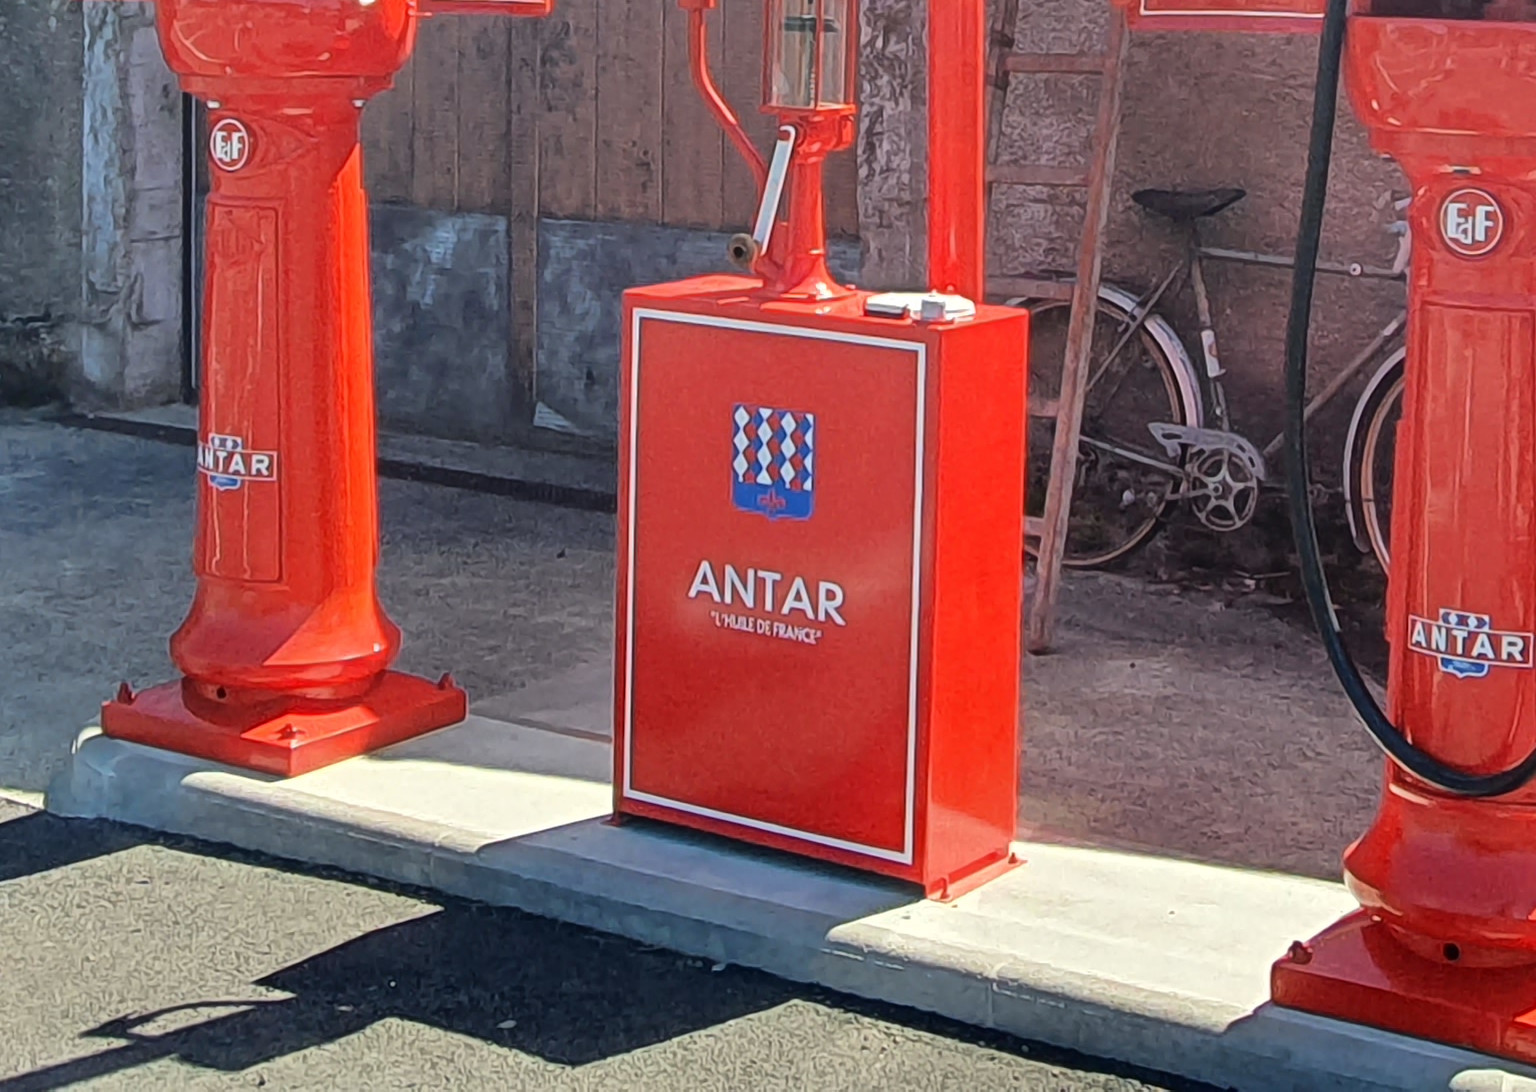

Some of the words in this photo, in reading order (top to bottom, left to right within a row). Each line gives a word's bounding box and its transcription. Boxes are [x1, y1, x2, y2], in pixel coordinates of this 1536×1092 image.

[687, 559, 847, 626] ANTAR
[756, 618, 771, 636] DE
[1411, 621, 1525, 662] ANTAR
